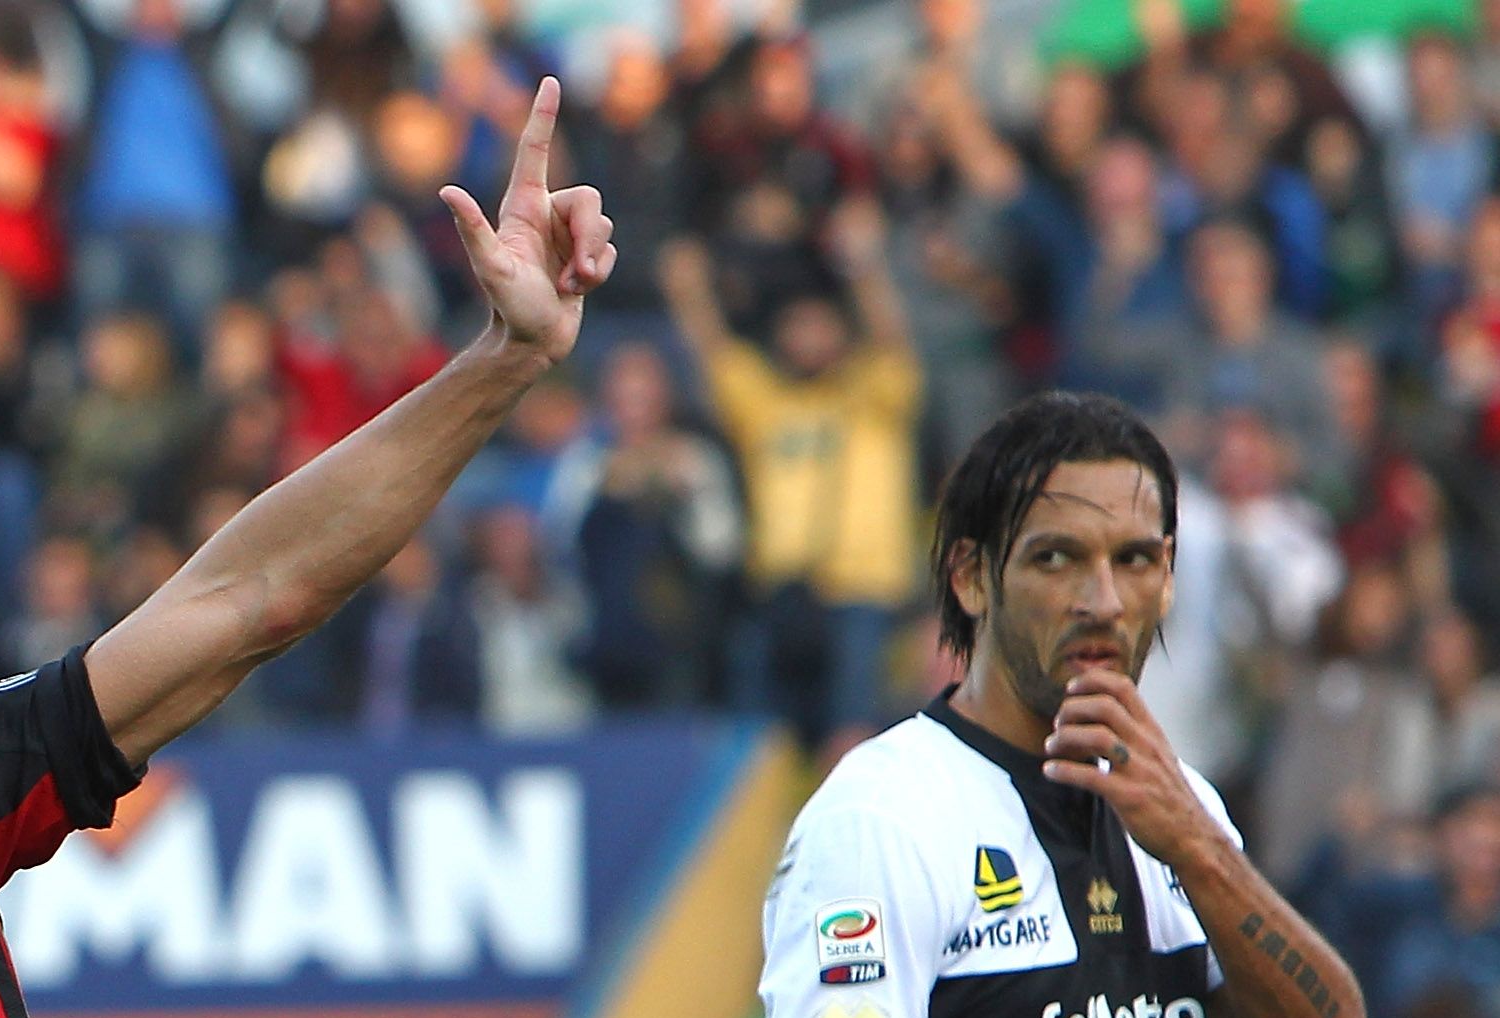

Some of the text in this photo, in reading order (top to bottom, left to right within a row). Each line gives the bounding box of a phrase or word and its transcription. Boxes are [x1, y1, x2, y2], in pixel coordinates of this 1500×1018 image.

[0, 768, 582, 985] MAN
[864, 941, 875, 954] A
[851, 963, 880, 982] TIM
